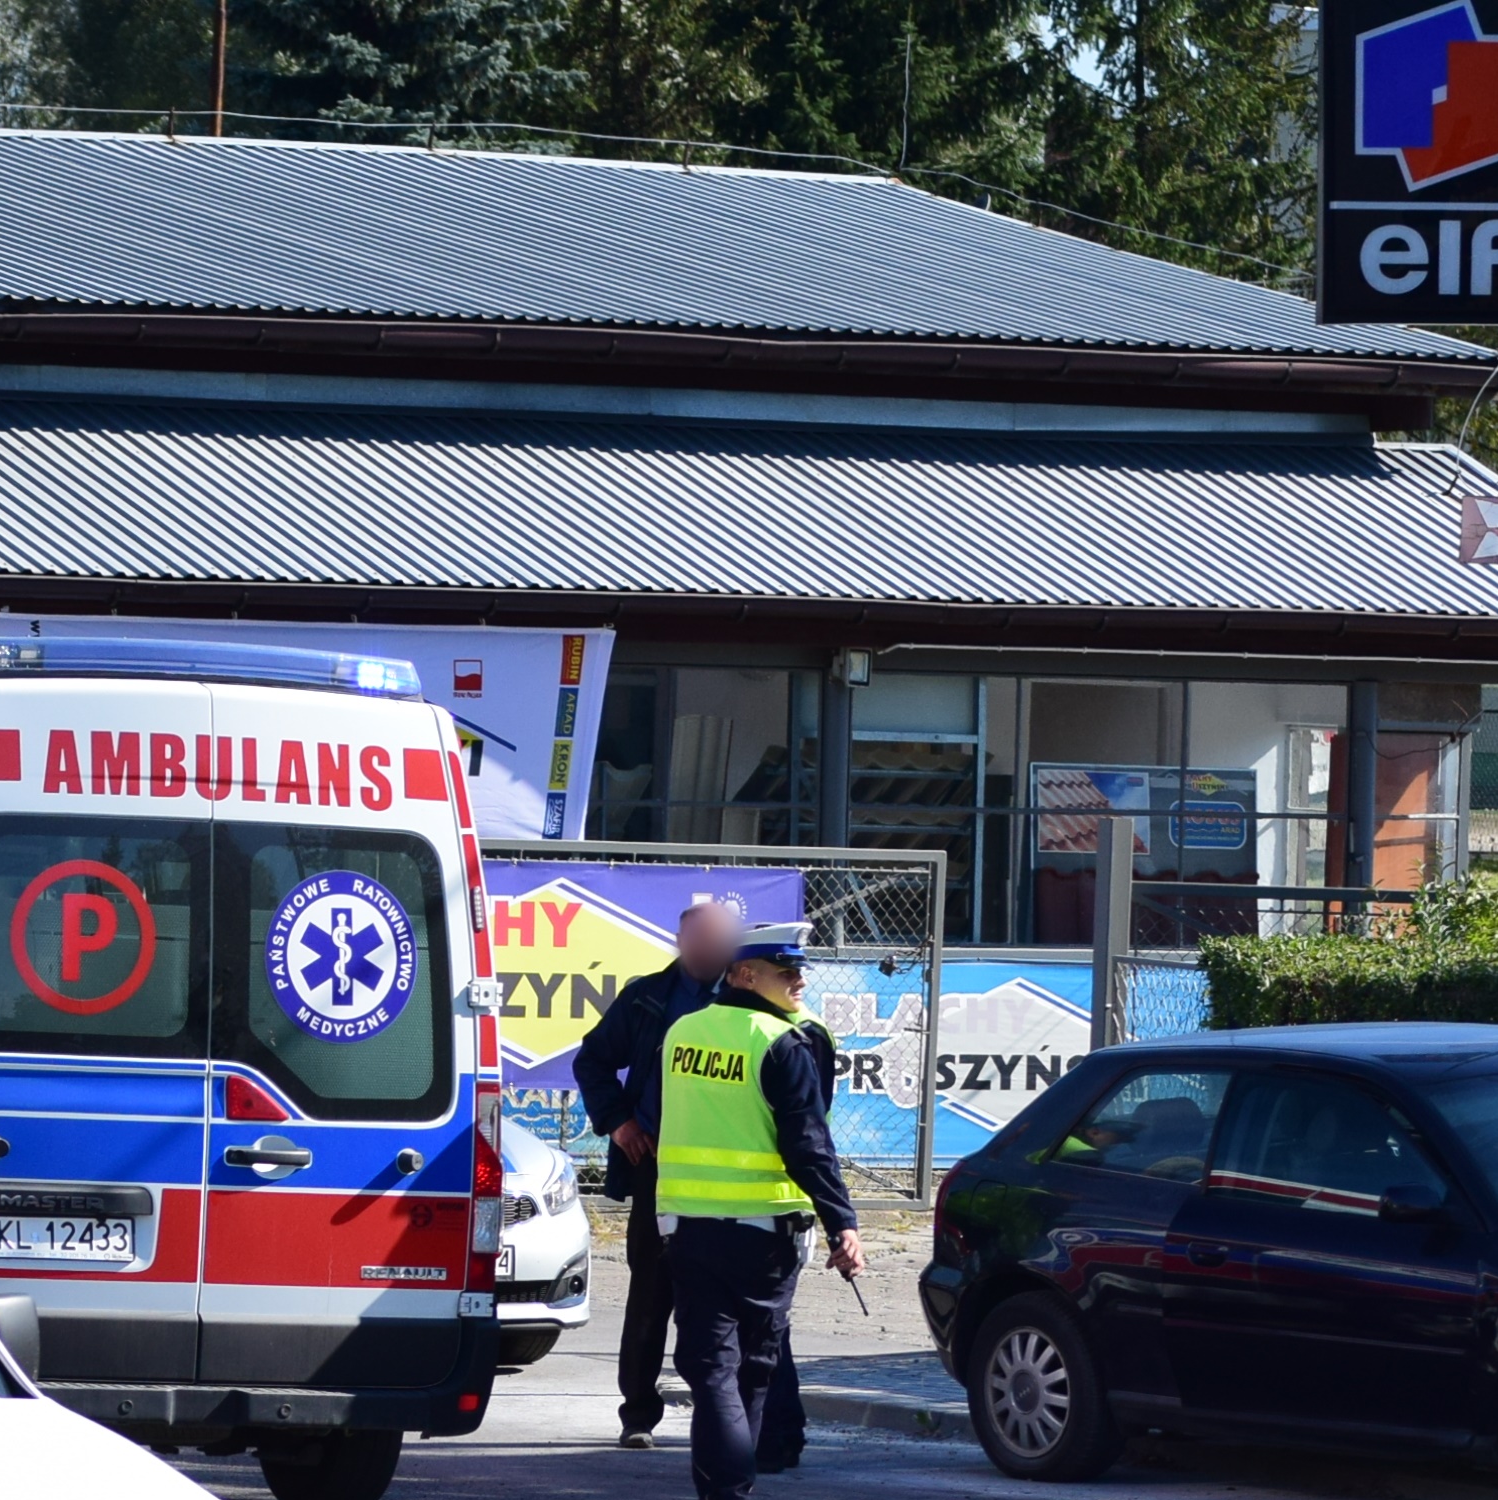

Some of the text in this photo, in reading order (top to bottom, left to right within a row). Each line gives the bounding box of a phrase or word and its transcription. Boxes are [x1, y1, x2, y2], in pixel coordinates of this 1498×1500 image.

[570, 636, 584, 680] RUBIN
[563, 693, 576, 734] ARAD
[43, 729, 393, 811] AMBULANS
[556, 743, 570, 783] KRON
[551, 799, 564, 834] SZAFIR
[60, 893, 117, 981] P
[269, 878, 412, 991] PAŃSTWOWE RATOWNICTWO
[494, 901, 583, 947] HY
[297, 1006, 389, 1036] MEDYCZNE
[825, 997, 1034, 1034] BLACHY
[671, 1046, 744, 1082] POLICJA
[0, 1193, 104, 1211] MASTER
[46, 1221, 128, 1251] 12433
[361, 1266, 447, 1280] RENAULT
